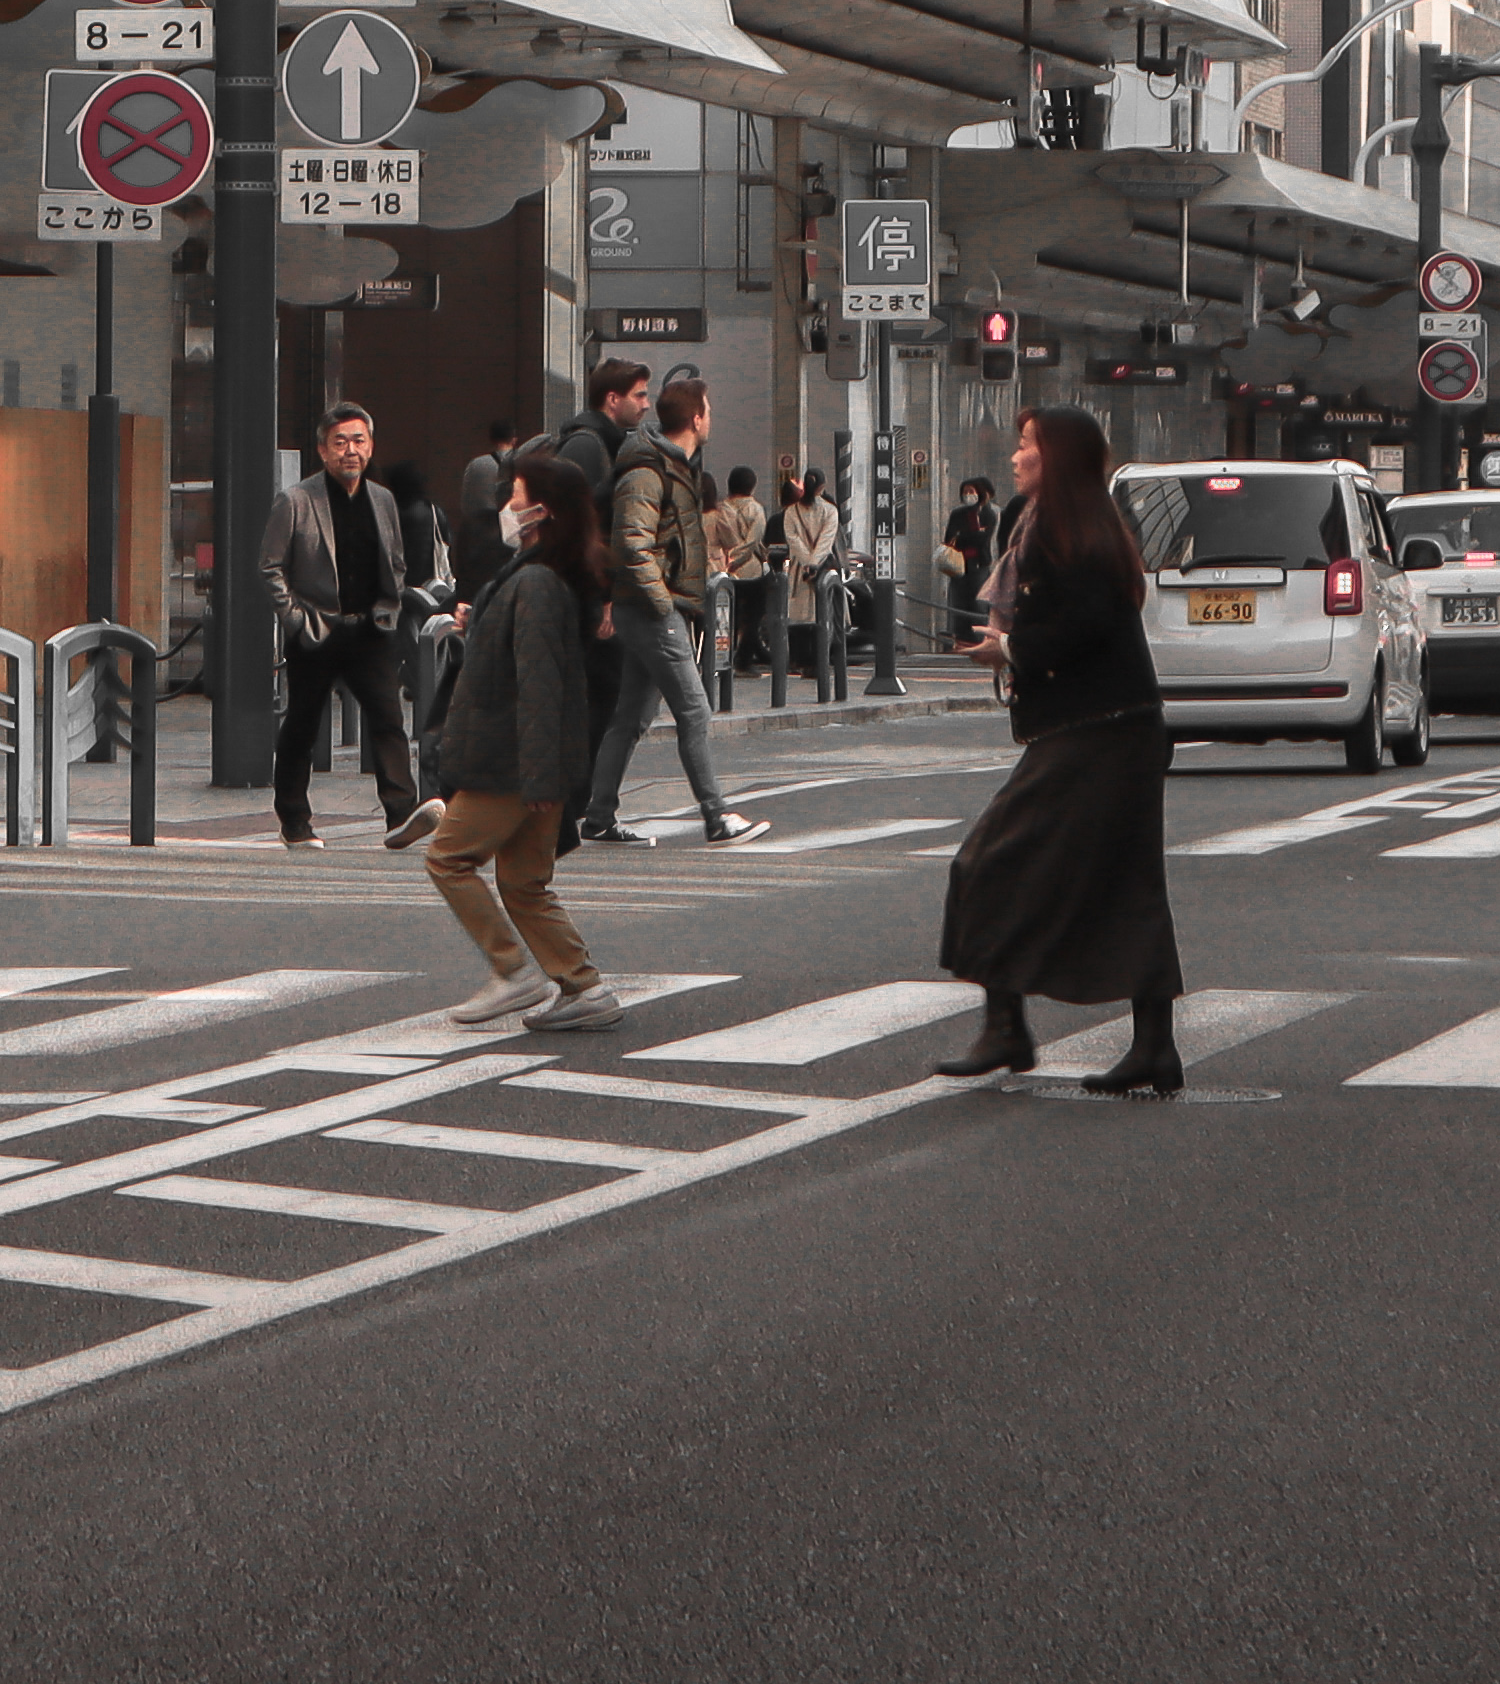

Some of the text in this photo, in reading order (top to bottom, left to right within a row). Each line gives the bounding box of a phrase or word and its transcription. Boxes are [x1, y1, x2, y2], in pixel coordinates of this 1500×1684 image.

[44, 205, 154, 231] ここから
[590, 247, 632, 257] GROUND
[857, 214, 915, 273] 停
[848, 292, 926, 314] ここまで
[1202, 602, 1253, 620] 66-90
